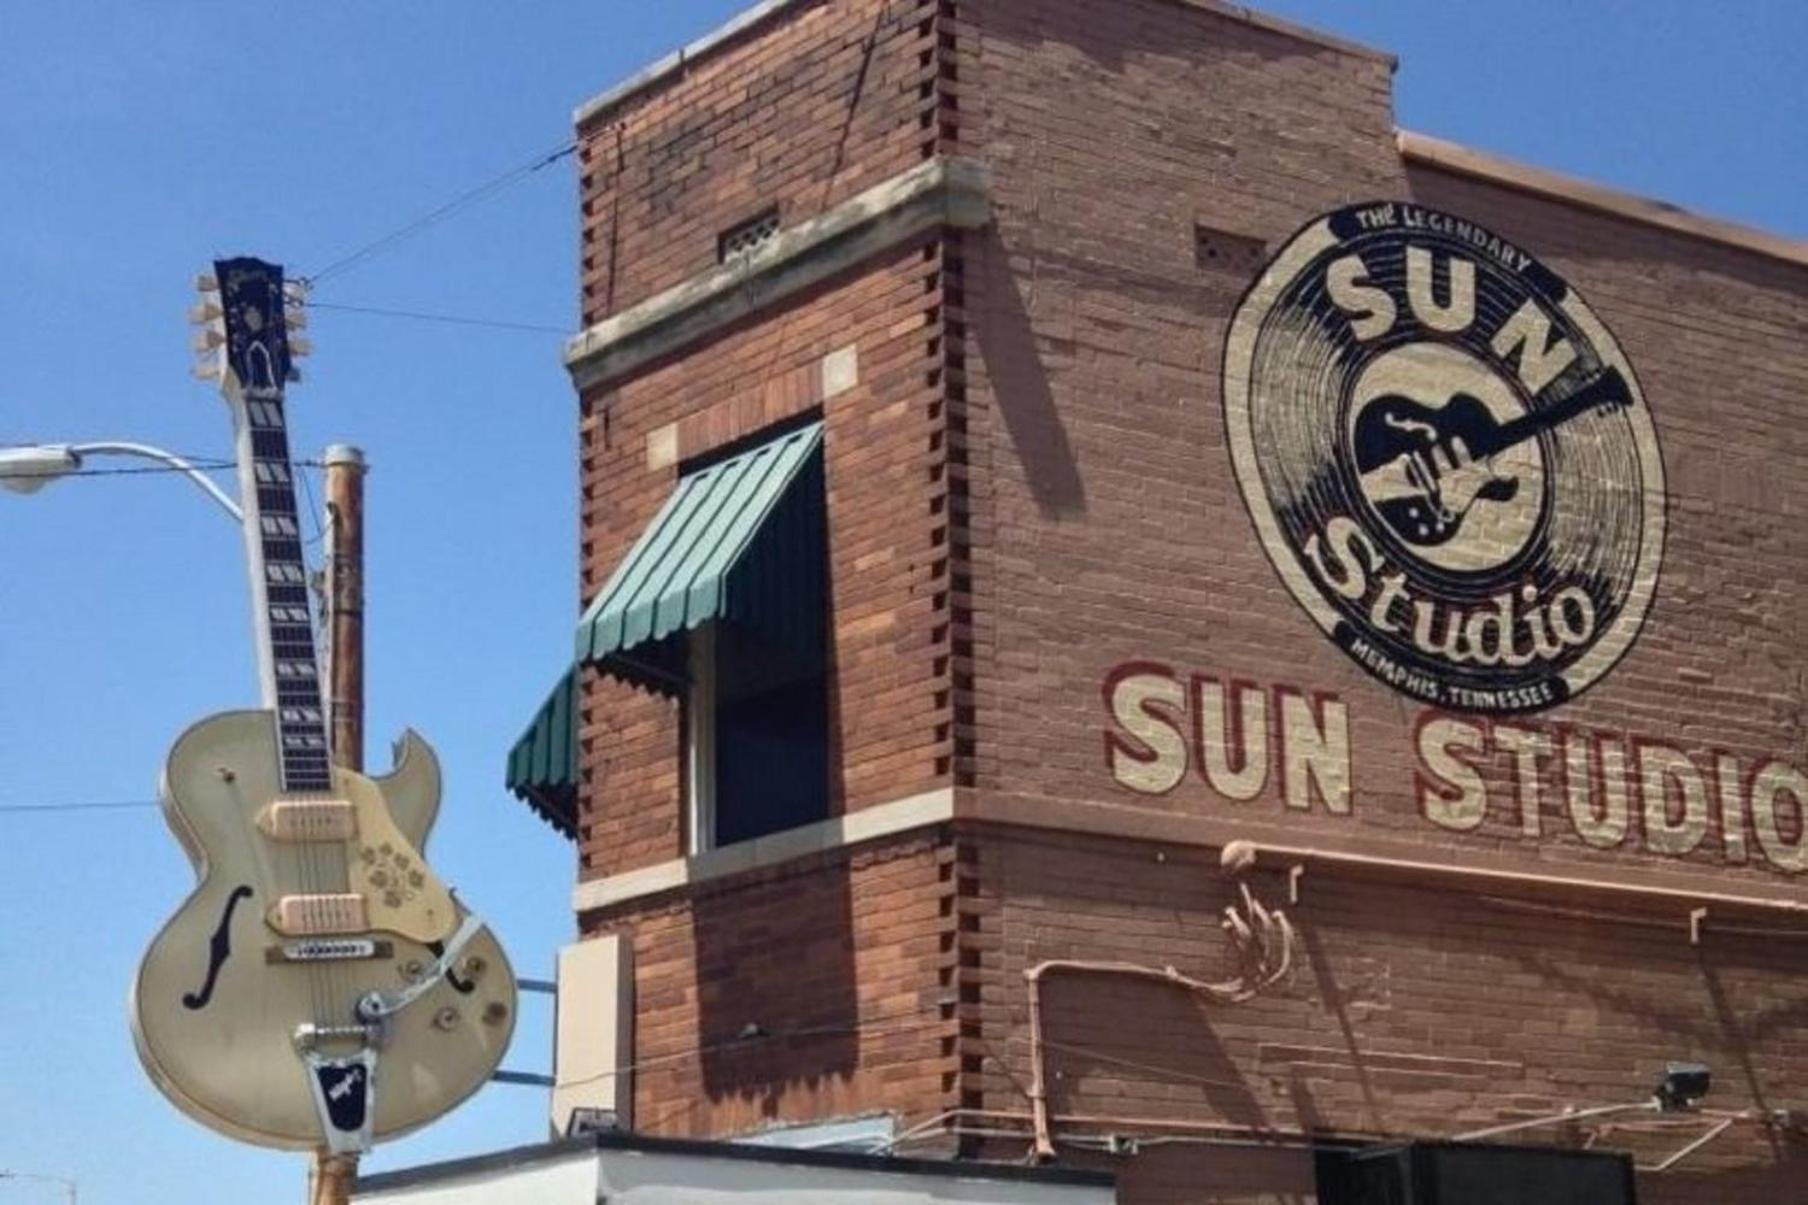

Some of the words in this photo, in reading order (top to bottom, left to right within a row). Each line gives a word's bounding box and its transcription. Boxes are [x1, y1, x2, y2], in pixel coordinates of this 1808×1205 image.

[1356, 203, 1397, 229] THE
[1402, 205, 1533, 273] LEGENDARY
[1326, 245, 1578, 396] SUN
[1303, 516, 1596, 666] Studio
[1107, 663, 1352, 814] SUN
[1415, 712, 1808, 873] STUDIO
[1449, 682, 1554, 710] TENNESSEE
